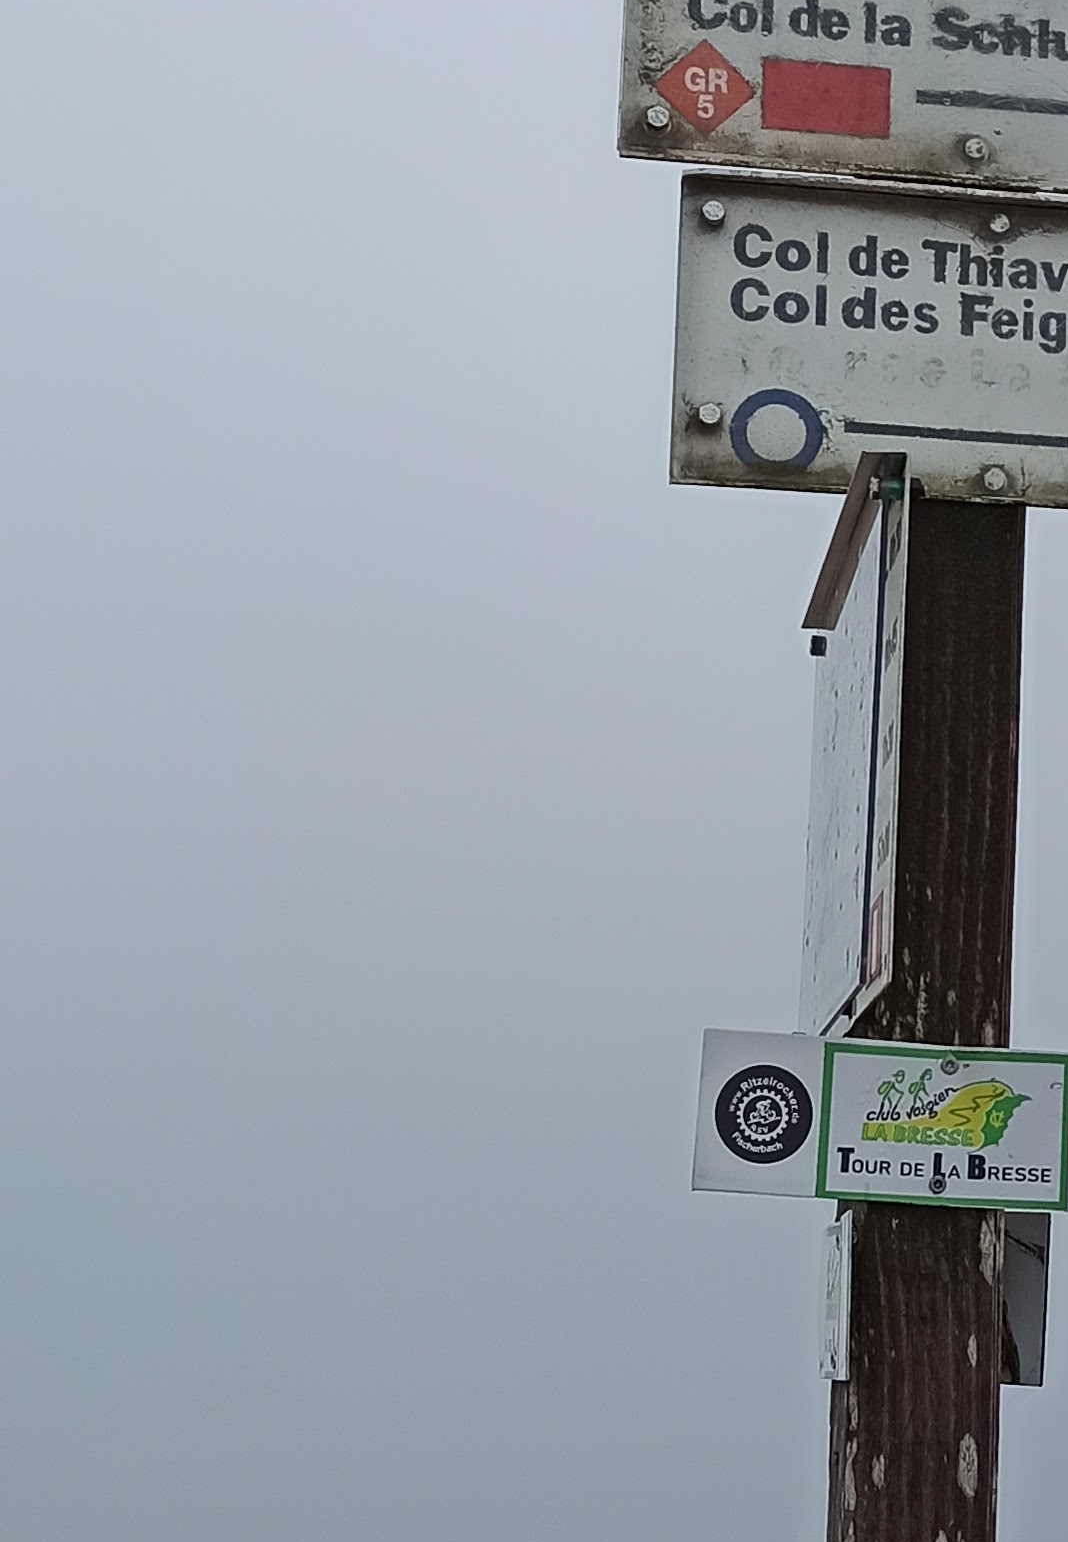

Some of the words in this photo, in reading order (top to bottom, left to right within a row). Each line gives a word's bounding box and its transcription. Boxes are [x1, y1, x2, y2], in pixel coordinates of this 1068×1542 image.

[863, 1, 913, 47] la
[684, 66, 729, 94] GR
[696, 94, 715, 119] 5
[734, 223, 830, 273] Col
[848, 235, 910, 279] de
[730, 278, 828, 327] Col
[841, 287, 940, 334] des
[865, 1102, 901, 1122] club
[861, 1123, 889, 1142] LA
[893, 1126, 975, 1148] BRESSE
